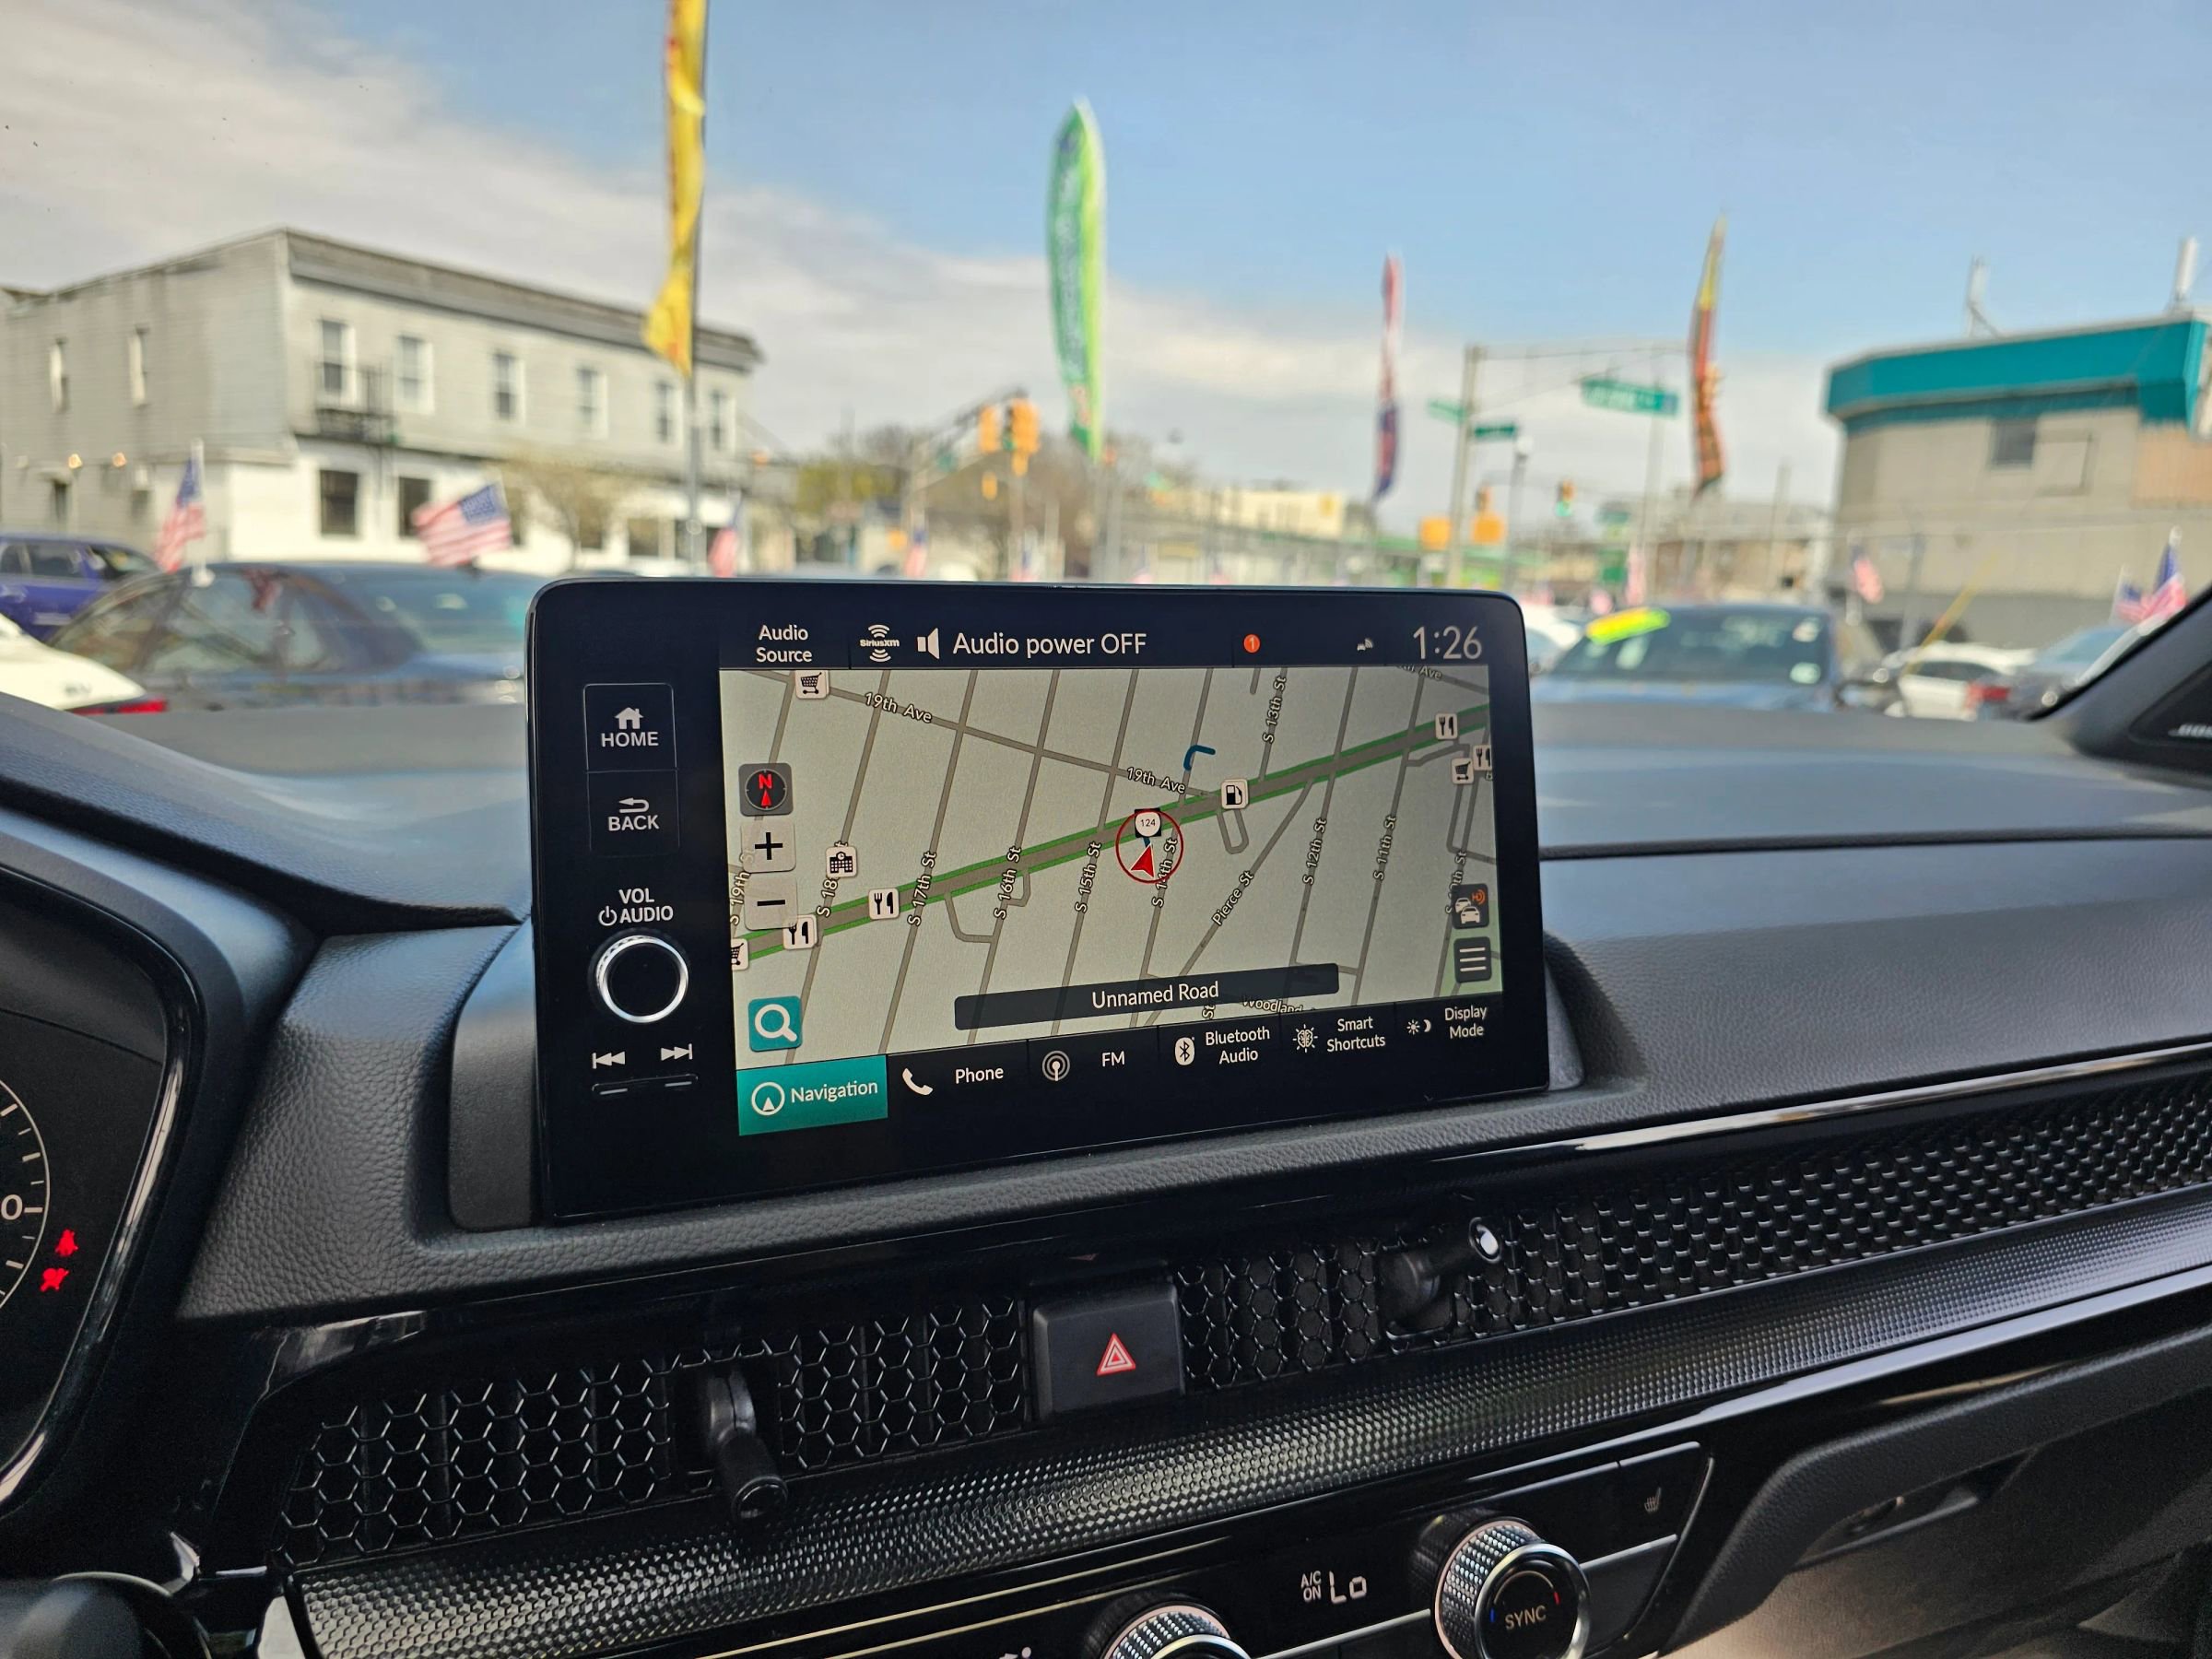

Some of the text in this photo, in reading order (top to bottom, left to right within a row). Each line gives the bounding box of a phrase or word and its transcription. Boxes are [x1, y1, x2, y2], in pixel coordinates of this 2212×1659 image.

[759, 624, 809, 641] Audio
[953, 632, 1147, 659] Audio power OFF
[1413, 627, 1483, 660] 1:26
[756, 646, 813, 664] Source
[1419, 665, 1442, 680] Ave
[865, 691, 933, 724] 19th Ave
[1263, 676, 1287, 744] S 13th St
[601, 731, 660, 748] HOME
[759, 773, 773, 790] N
[1126, 766, 1186, 794] 19th Ave
[607, 814, 660, 832] BACK
[1140, 818, 1156, 828] 124
[1302, 817, 1327, 887] S 12th St
[1372, 814, 1396, 882] S 11th St
[994, 845, 1022, 921] S 16th St
[1075, 840, 1101, 914] S 15th St
[1151, 896, 1165, 908] S
[1164, 837, 1179, 854] St
[618, 888, 655, 905] VOL
[731, 870, 751, 906] 19th
[907, 850, 937, 927] S 17th St
[1211, 869, 1254, 926] Pierce St
[619, 904, 675, 924] AUDIO
[729, 913, 741, 926] S
[816, 905, 831, 918] S
[1091, 980, 1219, 1010] Unnamed Road
[1202, 1004, 1216, 1020] St
[1444, 1004, 1488, 1024] Display
[1337, 1014, 1373, 1032] Smart
[1449, 1022, 1484, 1040] Mode
[1205, 1024, 1271, 1047] Bluetooth
[1326, 1031, 1386, 1053] Shortcuts
[1101, 1051, 1125, 1067] FM
[1218, 1046, 1259, 1065] Audio
[955, 1064, 1005, 1085] Phone
[791, 1079, 878, 1105] Navigation
[1301, 1571, 1322, 1587] A/C
[1329, 1571, 1368, 1605] Lo
[1303, 1586, 1322, 1603] ON
[1504, 1605, 1547, 1630] SYNC
